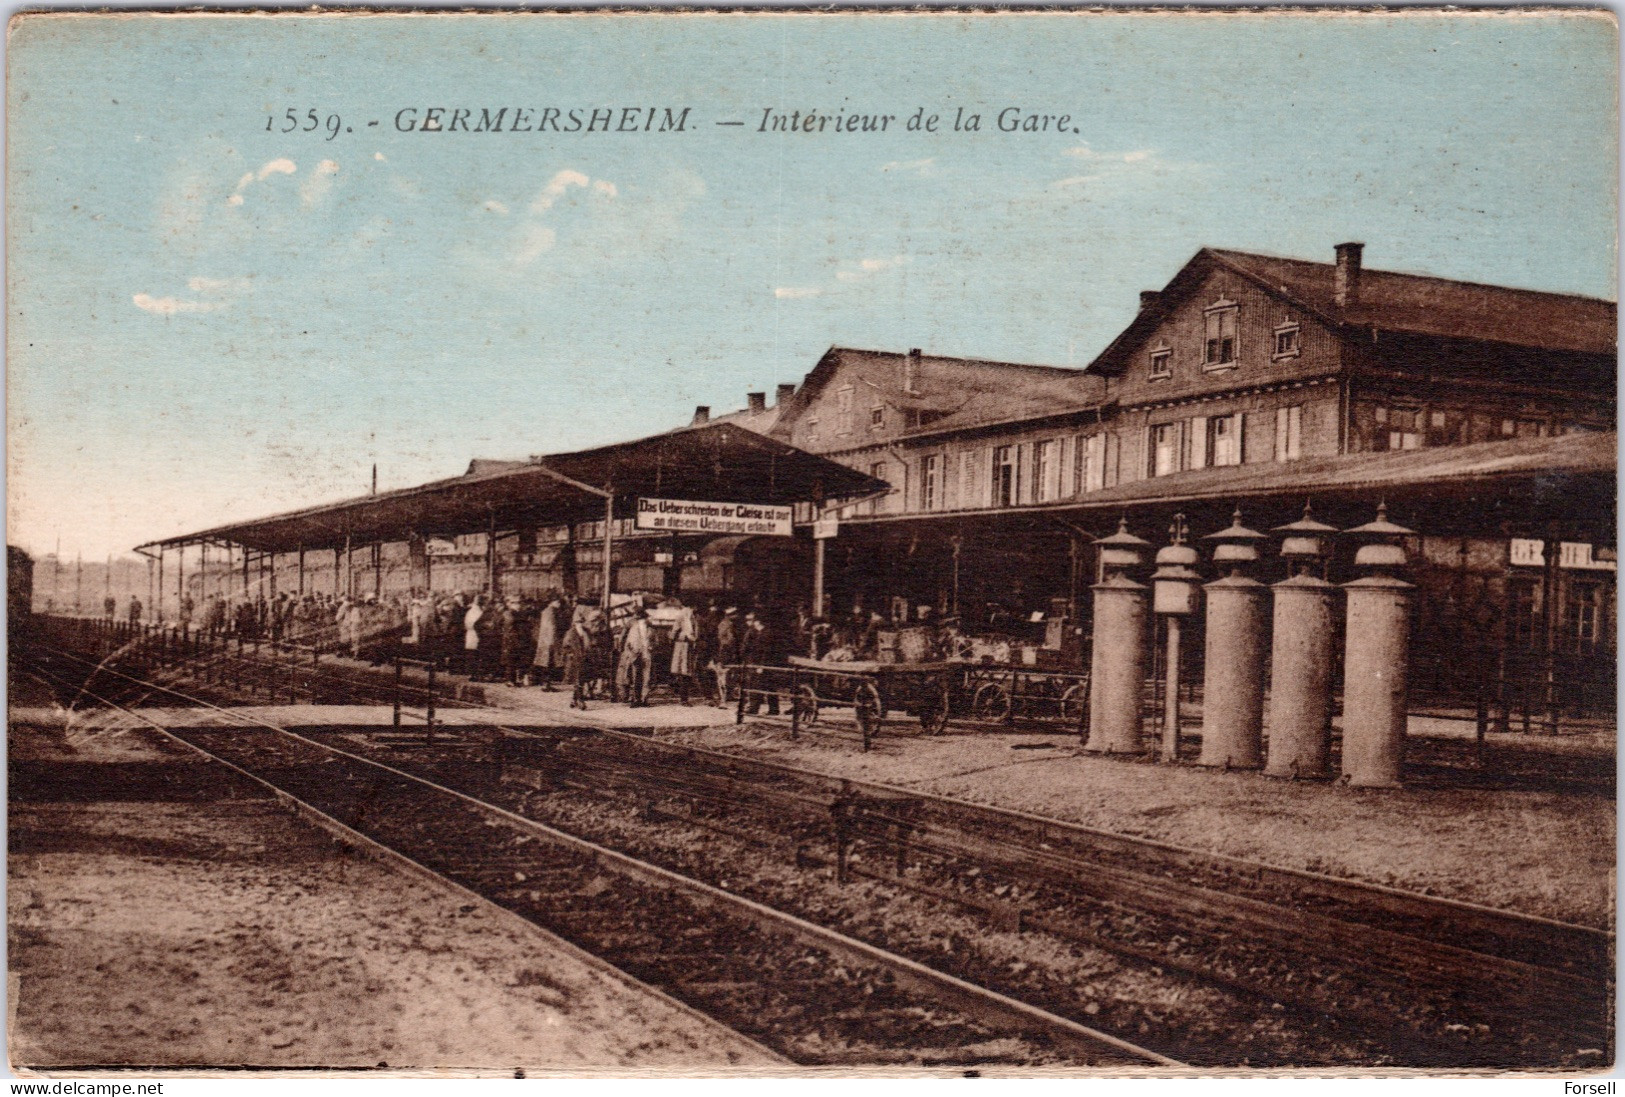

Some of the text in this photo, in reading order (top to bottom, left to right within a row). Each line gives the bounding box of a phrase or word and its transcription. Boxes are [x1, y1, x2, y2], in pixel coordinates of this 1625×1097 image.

[639, 499, 658, 513] Das
[659, 501, 720, 517] Ueberschreiten
[721, 506, 735, 517] der
[736, 505, 763, 519] Gleise
[764, 509, 775, 520] ist
[654, 517, 666, 527] an
[668, 517, 698, 529] diesem
